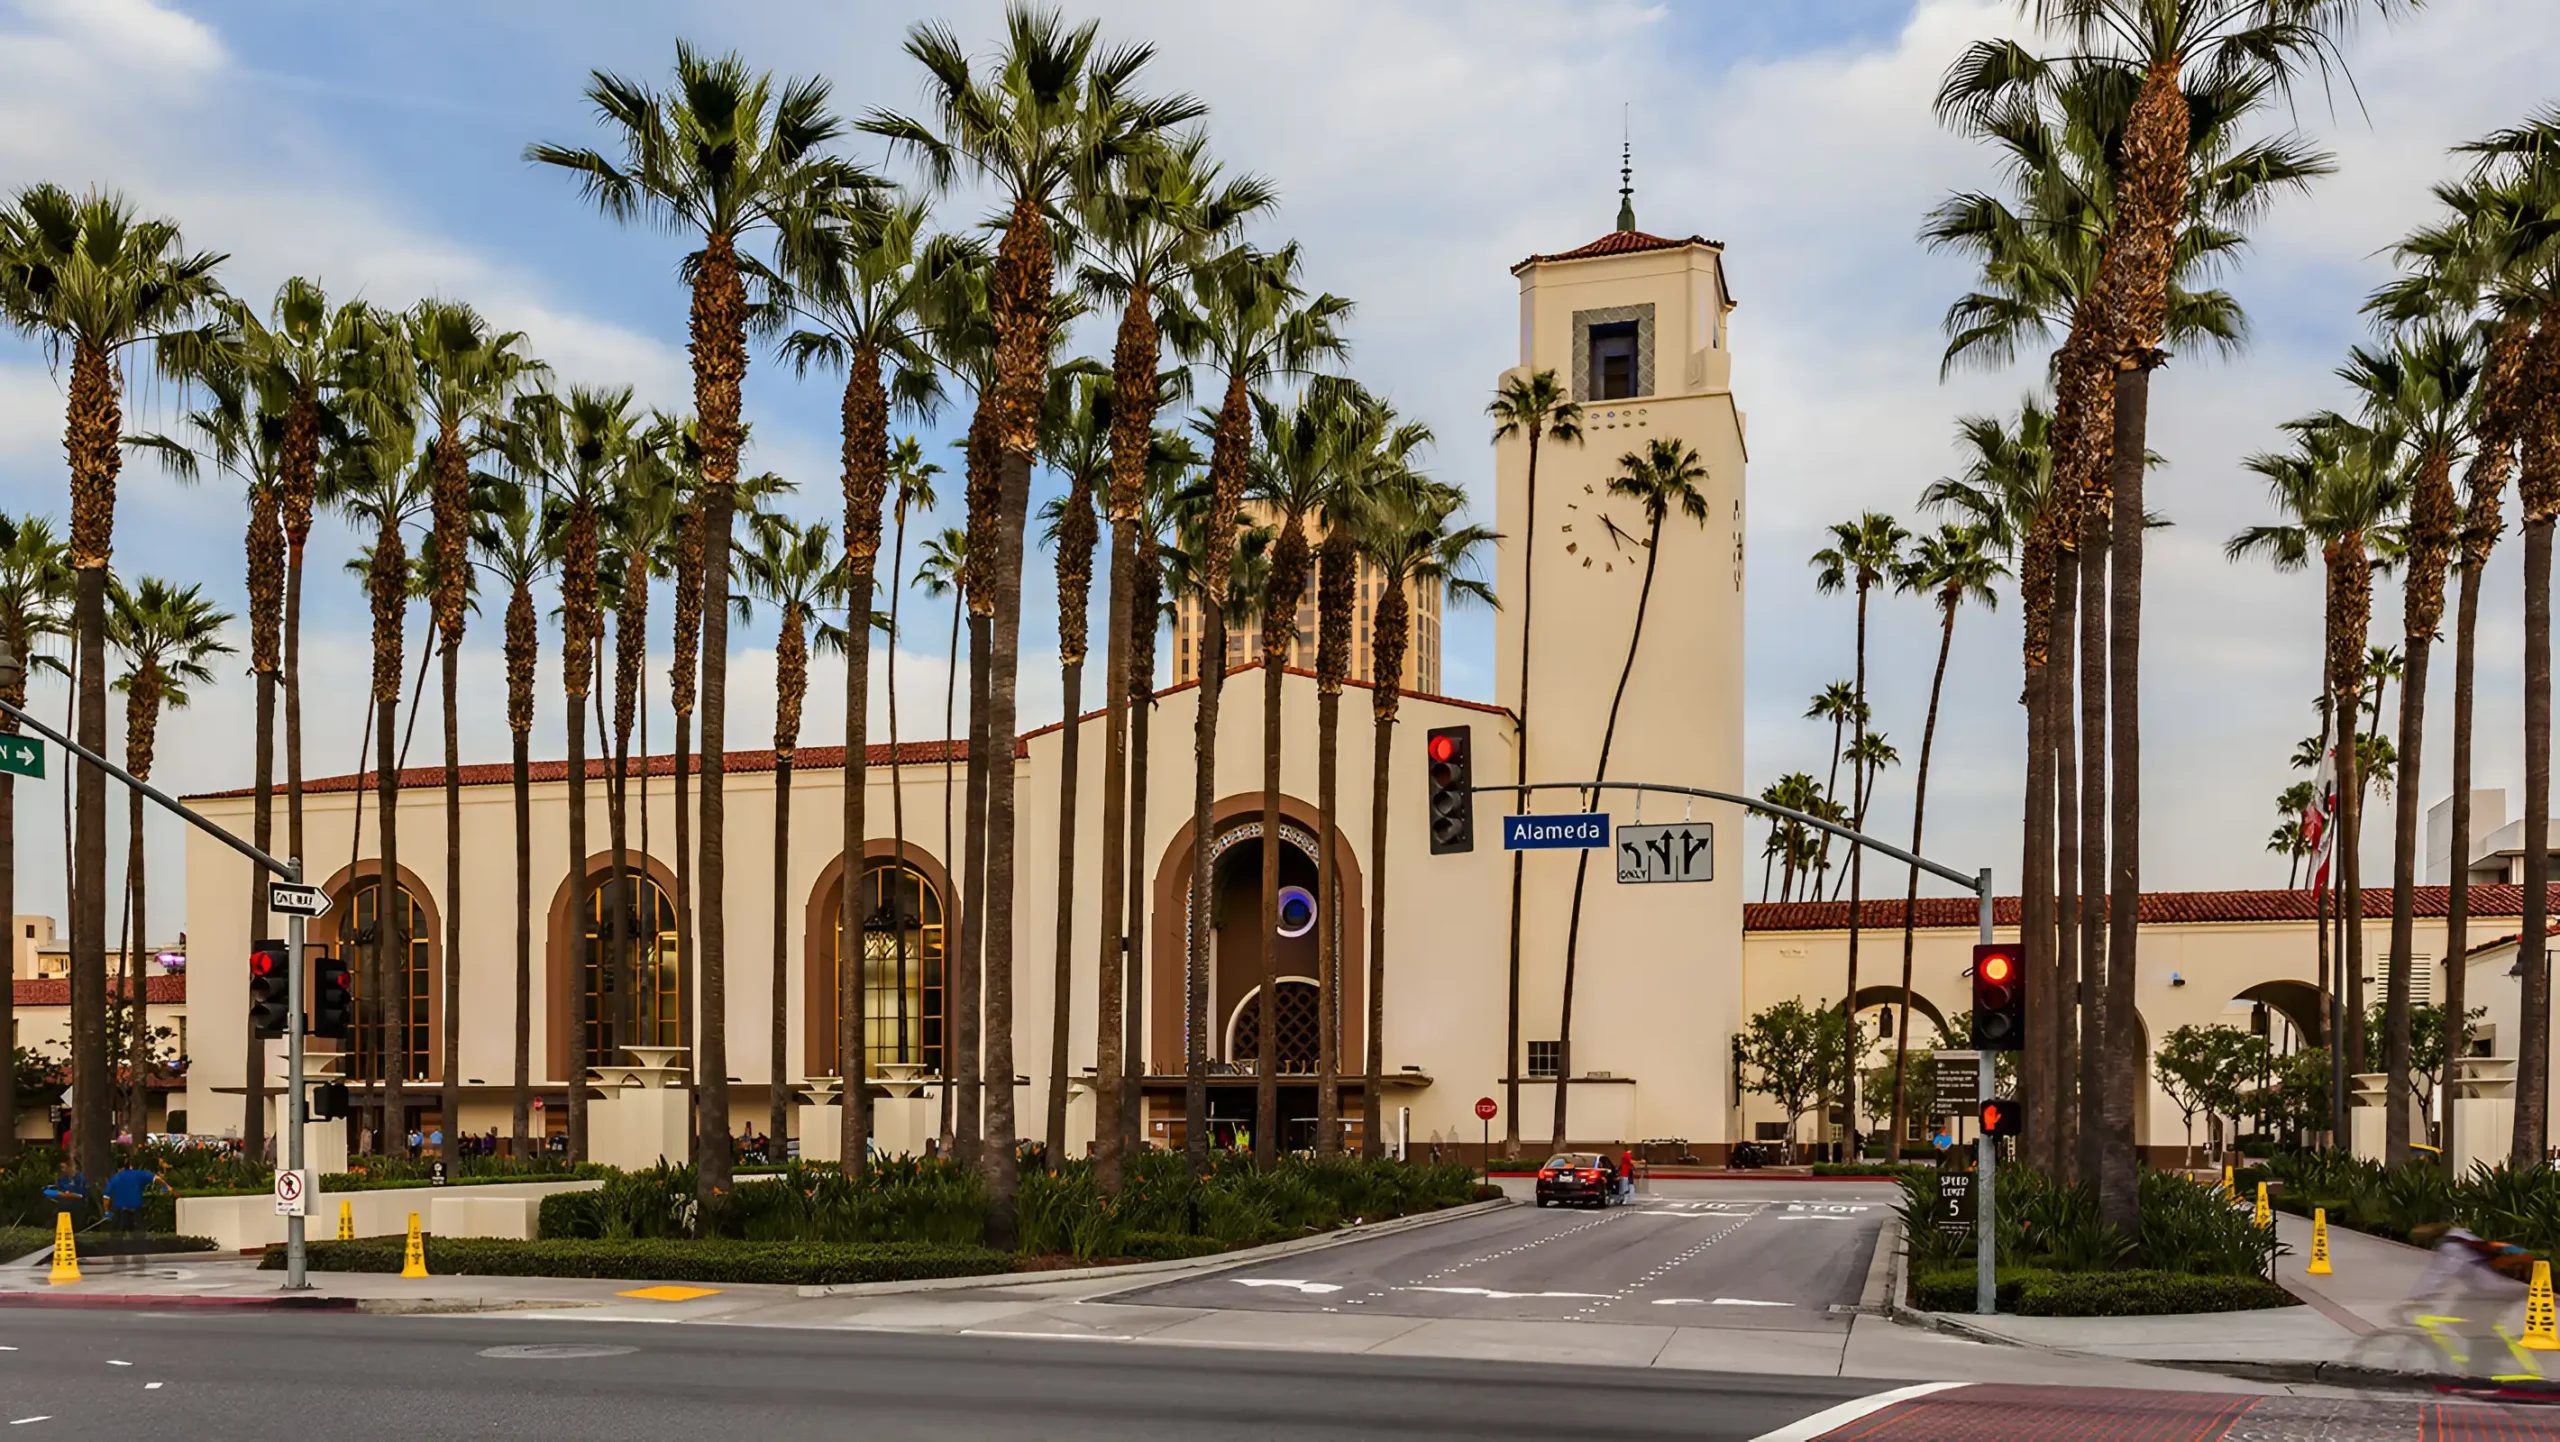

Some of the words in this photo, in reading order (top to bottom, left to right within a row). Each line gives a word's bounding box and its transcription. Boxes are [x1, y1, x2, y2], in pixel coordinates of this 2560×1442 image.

[1513, 822, 1600, 841] Alameda
[1620, 869, 1647, 880] ONLY
[1941, 1176, 1969, 1186] SPEED
[1942, 1187, 1966, 1197] LIMIT
[1787, 1204, 1868, 1213] STOP
[1949, 1199, 1959, 1216] 5
